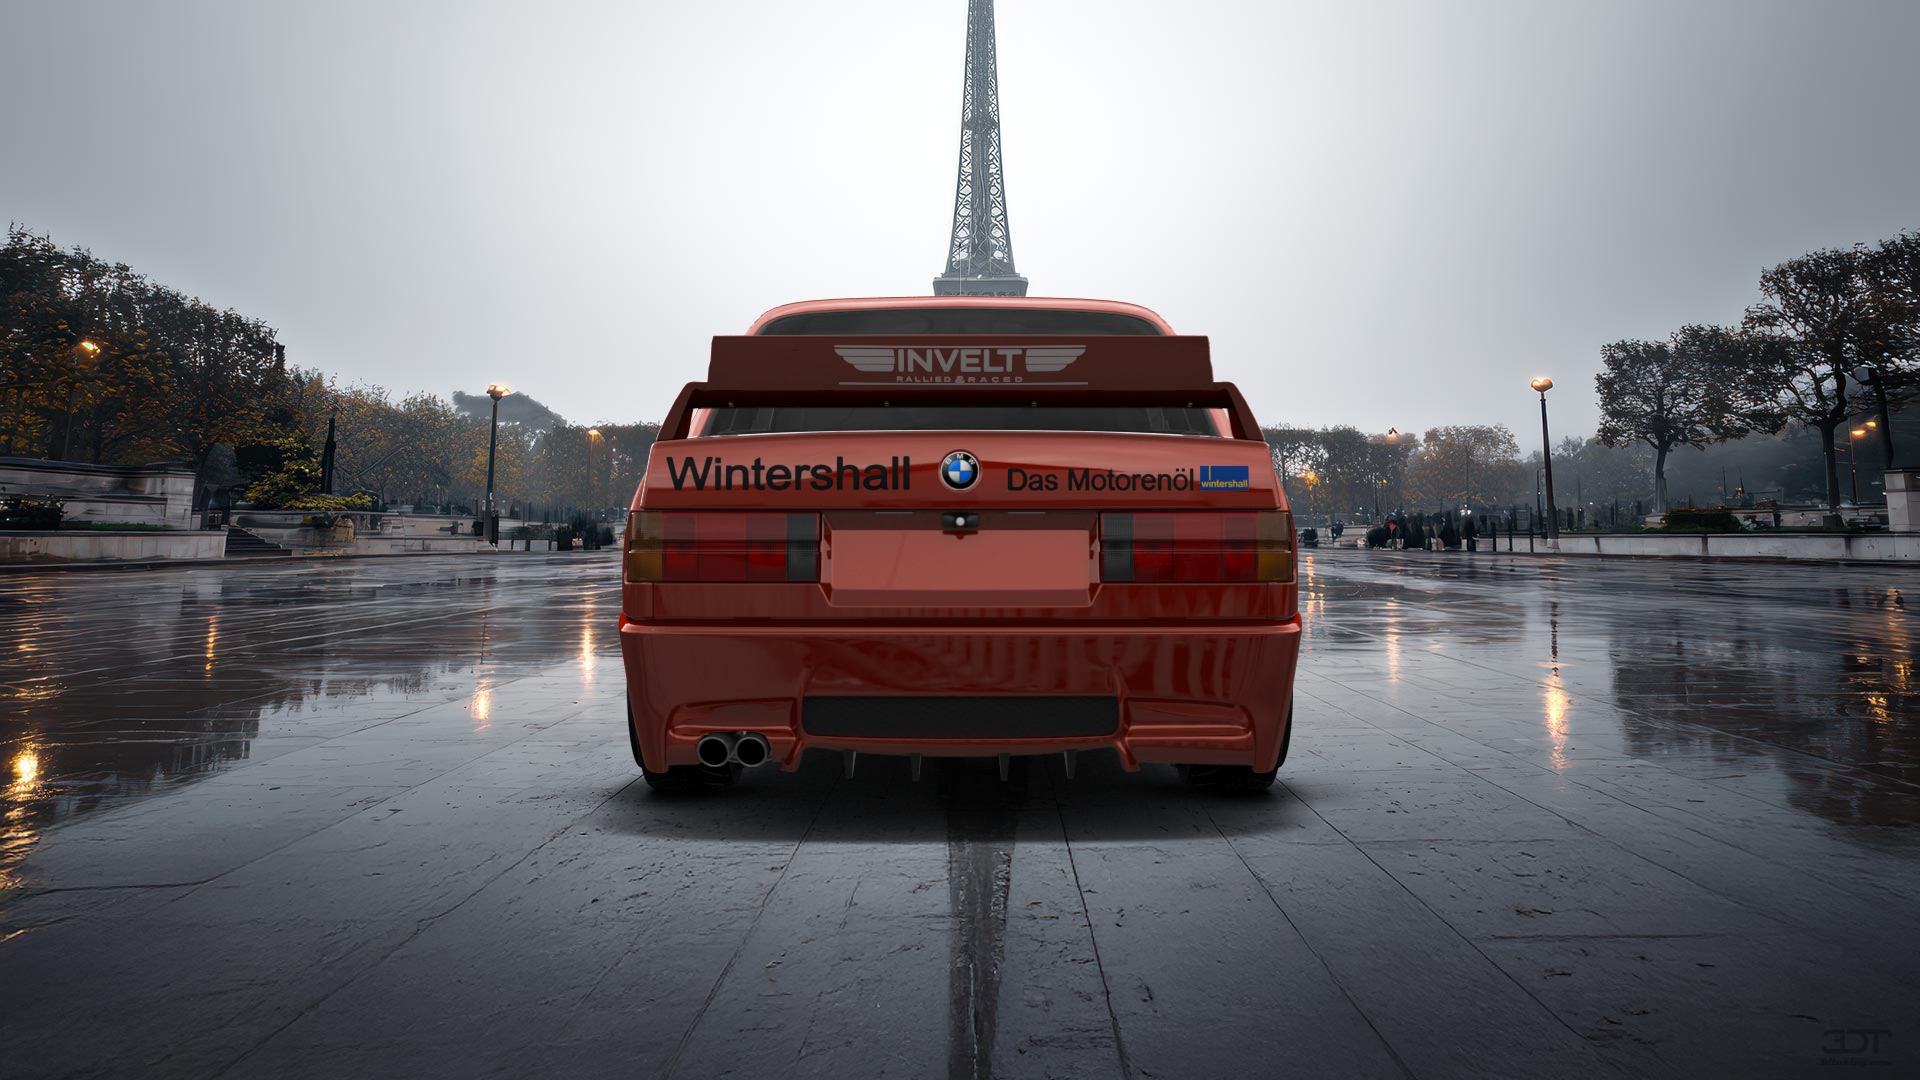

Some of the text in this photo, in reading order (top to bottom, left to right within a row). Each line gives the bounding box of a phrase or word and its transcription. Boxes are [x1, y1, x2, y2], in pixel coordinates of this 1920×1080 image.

[898, 349, 1022, 372] INVELT
[896, 375, 952, 383] RALLIED
[944, 453, 976, 465] BMW
[666, 456, 910, 491] Wintershall
[1007, 468, 1194, 491] Das Motorenöl
[1201, 478, 1248, 488] wintershall
